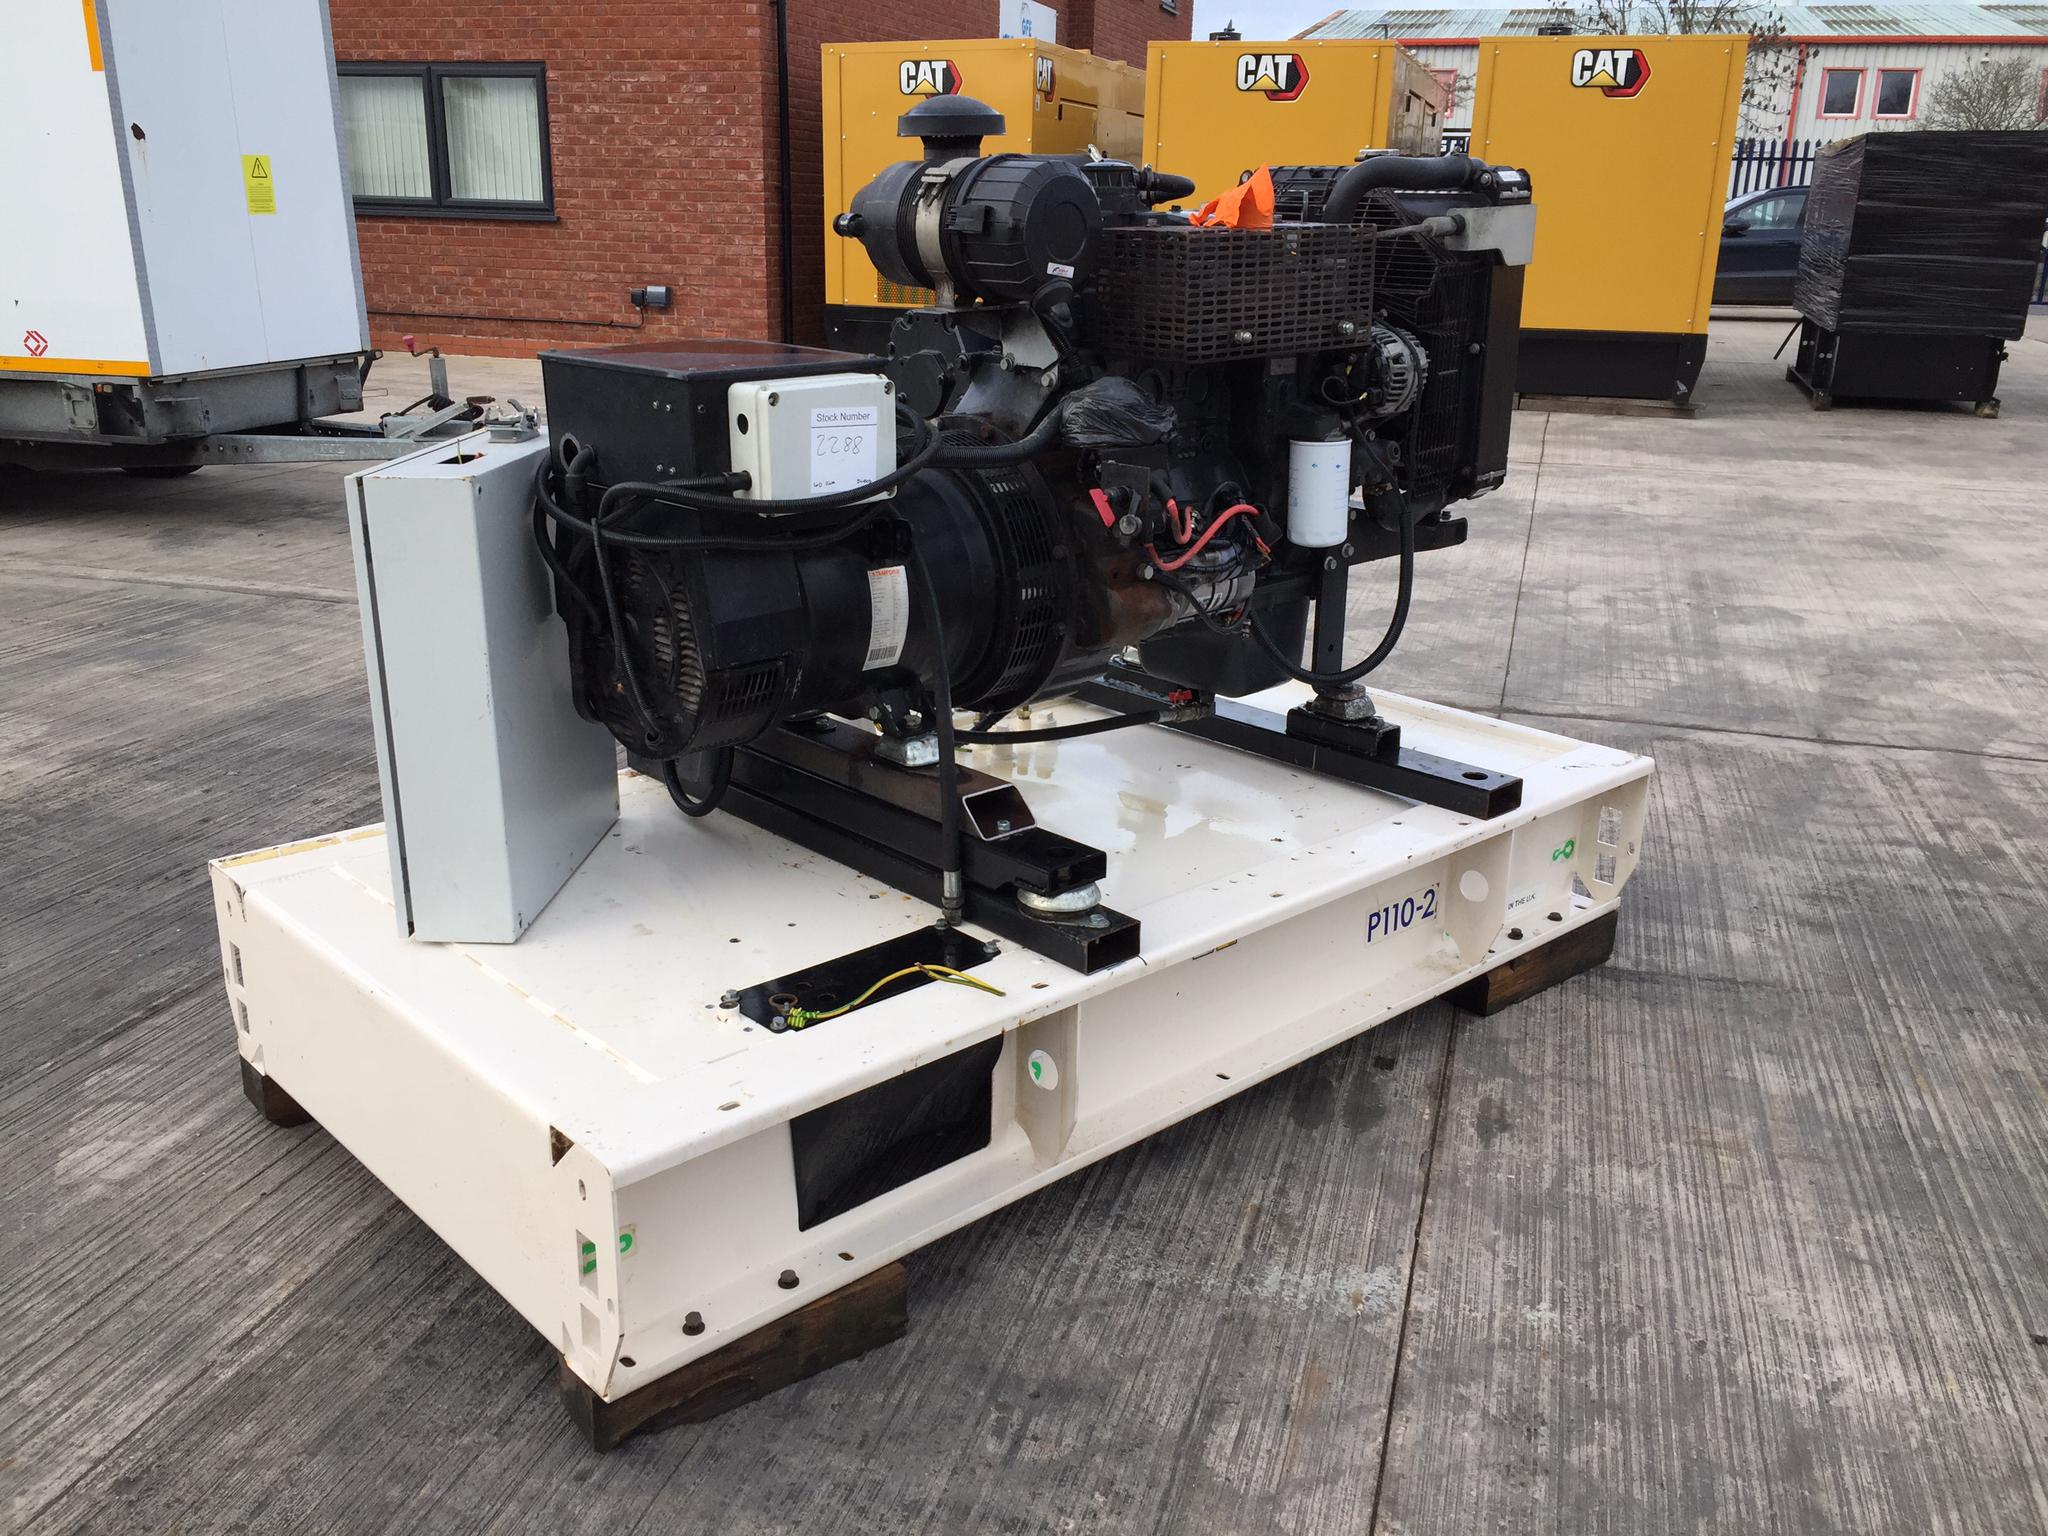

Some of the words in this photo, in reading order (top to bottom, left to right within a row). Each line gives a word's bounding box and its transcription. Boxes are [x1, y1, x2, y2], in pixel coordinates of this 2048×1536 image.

[900, 60, 947, 94] CAT
[1036, 56, 1052, 92] CAT
[1237, 54, 1293, 91] CAT
[1572, 50, 1634, 87] CAT
[816, 413, 838, 422] Stock
[840, 412, 871, 421] Number
[816, 434, 863, 457] 2288
[1367, 888, 1436, 943] P110-2
